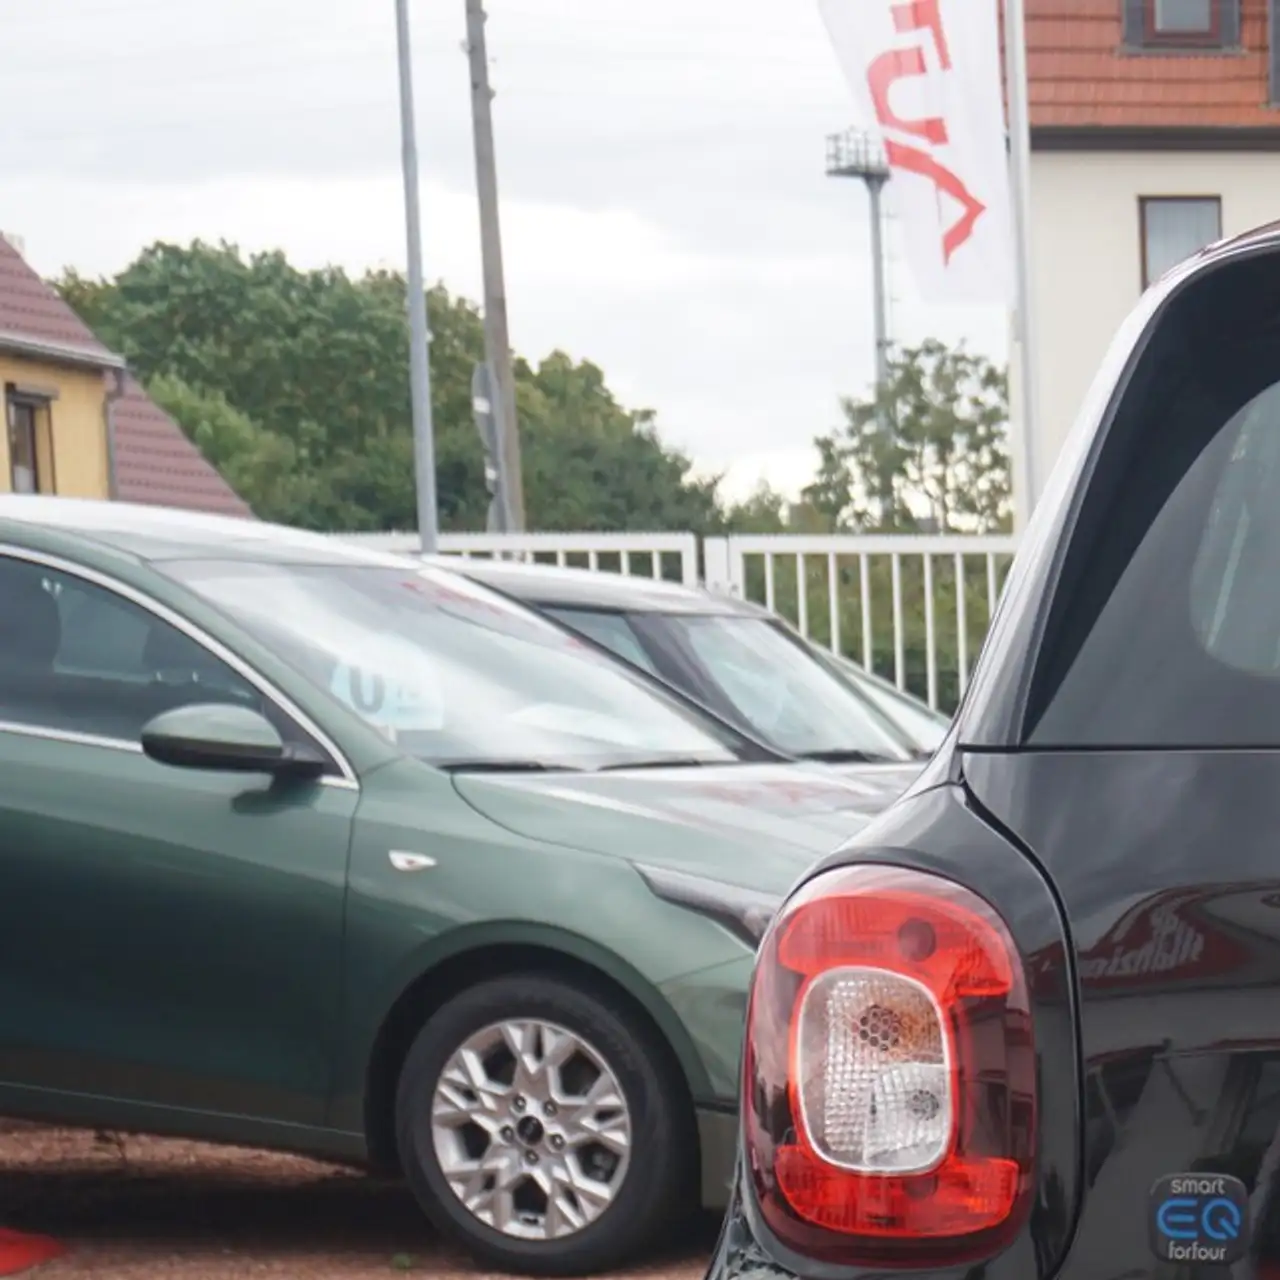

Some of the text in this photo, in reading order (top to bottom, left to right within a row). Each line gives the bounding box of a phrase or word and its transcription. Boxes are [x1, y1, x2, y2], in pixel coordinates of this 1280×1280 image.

[1171, 1178, 1225, 1195] smart
[1157, 1198, 1241, 1240] EQ
[1168, 1240, 1227, 1260] forfour
